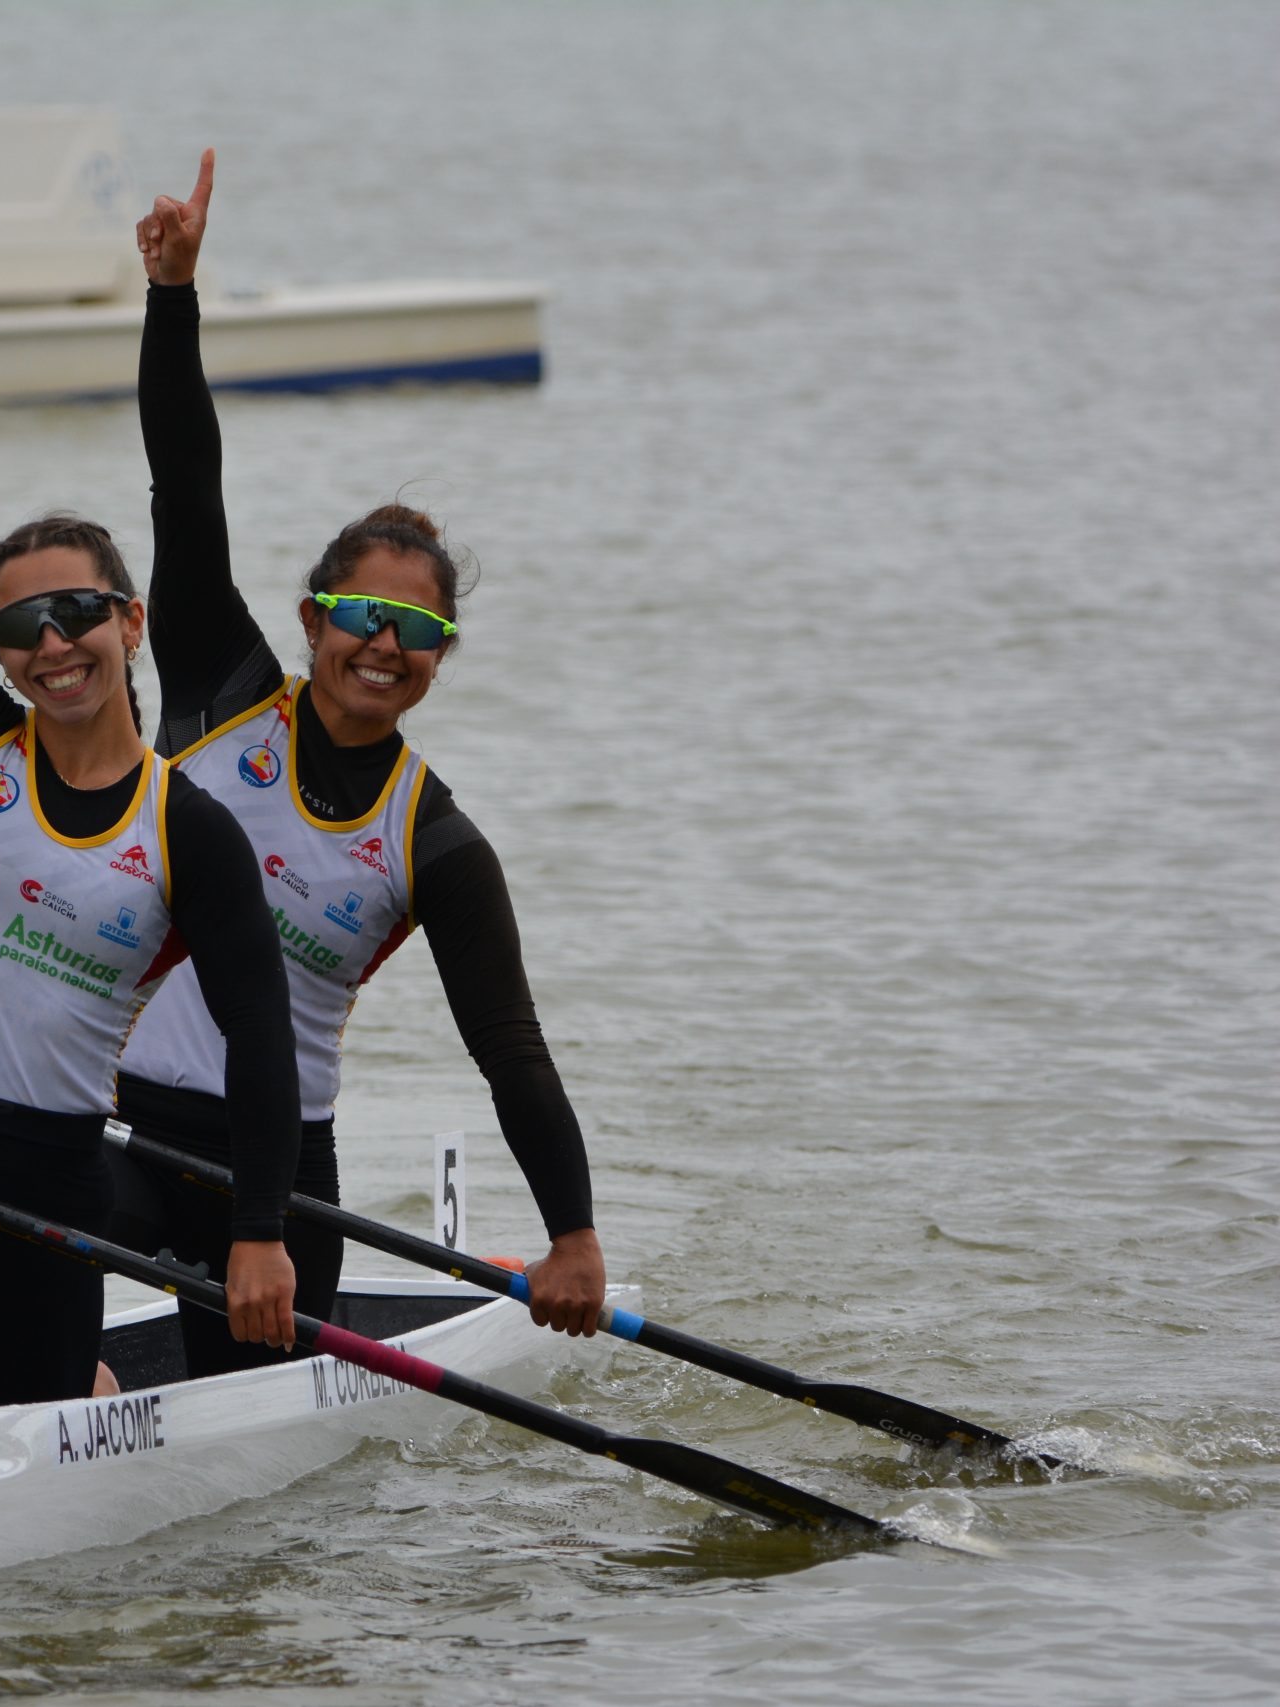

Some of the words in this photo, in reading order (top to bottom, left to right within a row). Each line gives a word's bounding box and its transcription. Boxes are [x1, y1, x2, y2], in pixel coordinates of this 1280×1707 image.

[45, 891, 74, 911] GRUPO
[281, 874, 310, 900] CALICHE
[285, 868, 309, 889] GRUPO
[42, 898, 77, 921] CALICHE
[0, 944, 58, 977] paraíso
[60, 971, 113, 999] natural
[3, 913, 121, 984] Asturias
[443, 1148, 458, 1250] 5
[312, 1356, 332, 1410] M.
[59, 1410, 79, 1464] A.
[84, 1394, 165, 1460] JACOME
